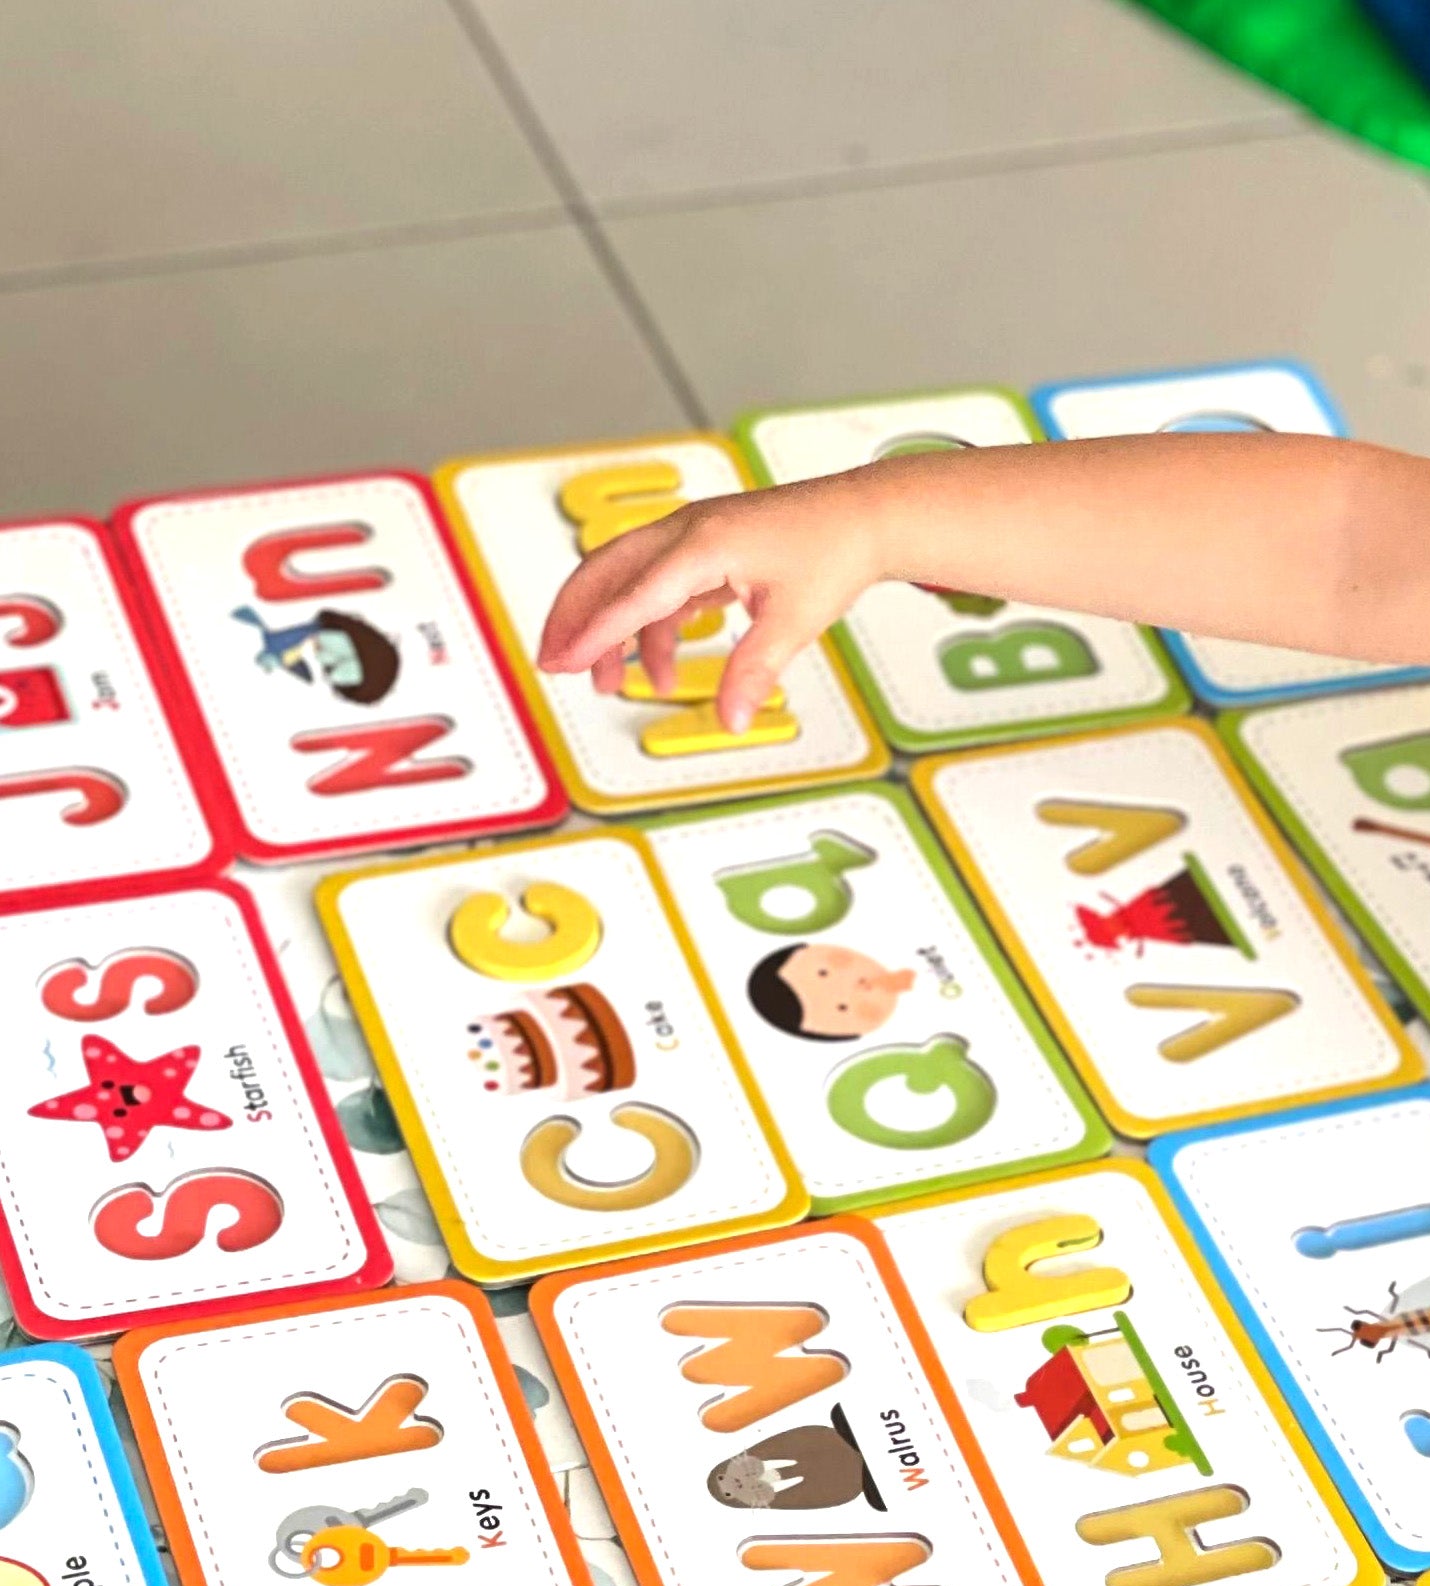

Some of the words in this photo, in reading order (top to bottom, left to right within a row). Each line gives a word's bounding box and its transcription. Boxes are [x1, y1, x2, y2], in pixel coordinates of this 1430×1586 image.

[241, 520, 392, 602] n
[937, 620, 1102, 693] B
[290, 714, 473, 797] N
[645, 1000, 681, 1052] Cake
[224, 1044, 272, 1123] Starfish
[822, 1032, 998, 1151] Q
[963, 1213, 1134, 1333] h
[1173, 1344, 1226, 1418] House
[879, 1407, 928, 1493] Walrus
[468, 1488, 507, 1550] Keys
